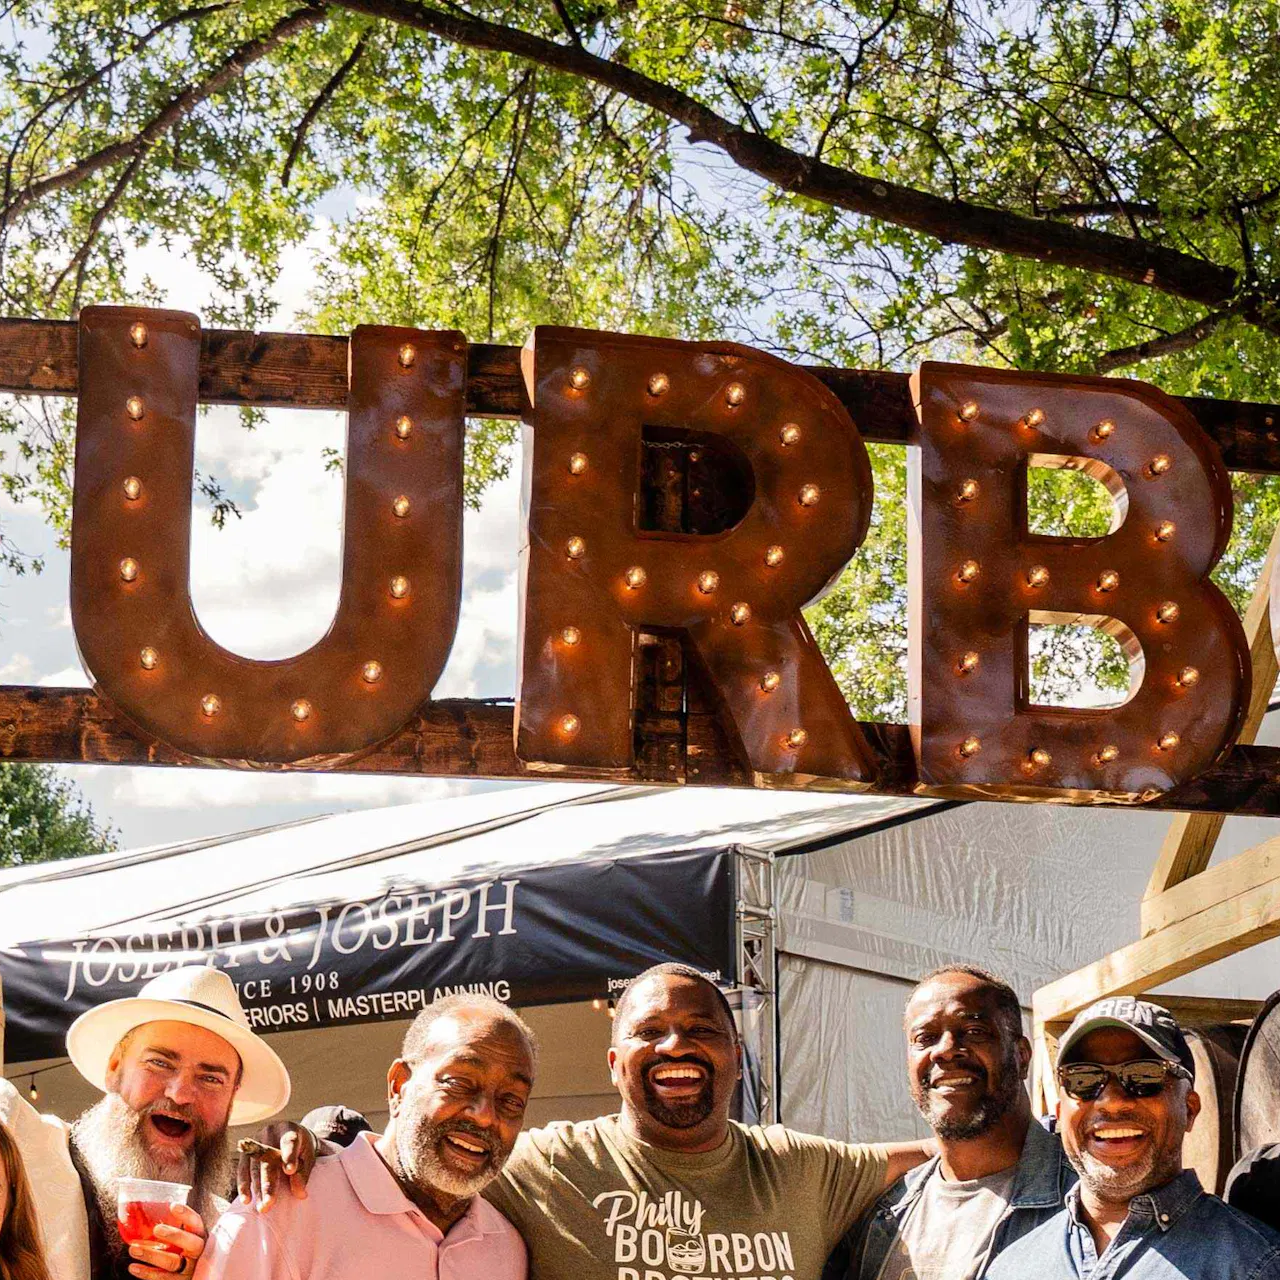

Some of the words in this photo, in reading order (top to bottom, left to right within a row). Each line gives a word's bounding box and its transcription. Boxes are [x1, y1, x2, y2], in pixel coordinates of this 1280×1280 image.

[64, 920, 243, 1001] JOSEPH
[257, 913, 301, 965] &
[306, 879, 520, 970] JOSEPH
[290, 970, 339, 995] 1908
[242, 1002, 310, 1027] RIORS
[592, 1190, 706, 1237] Philly
